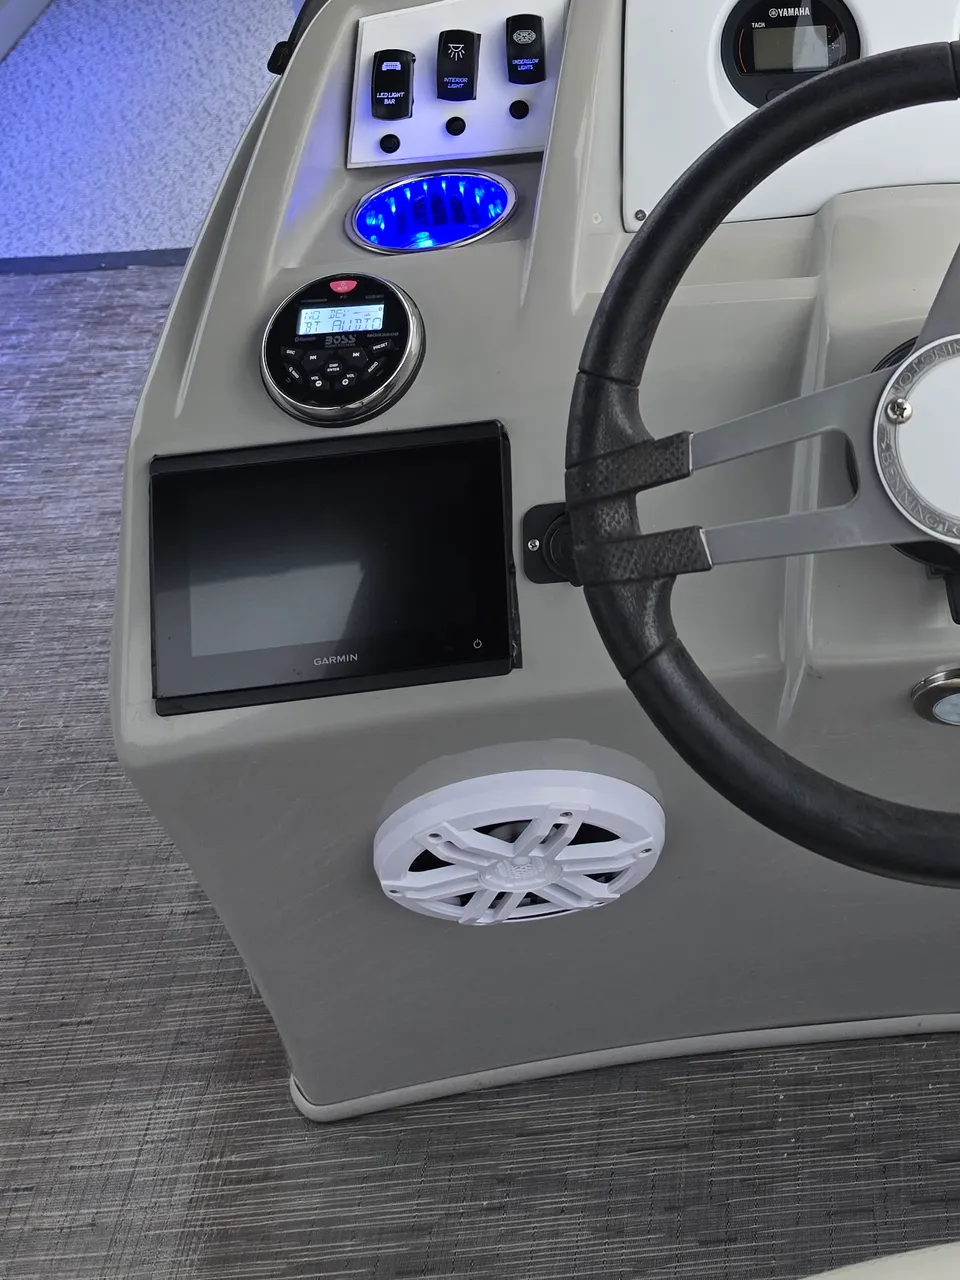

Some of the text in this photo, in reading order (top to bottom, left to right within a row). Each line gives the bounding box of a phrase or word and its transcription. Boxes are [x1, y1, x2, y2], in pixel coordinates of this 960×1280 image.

[778, 7, 811, 17] YAMAHA
[325, 334, 356, 345] BOSS
[313, 652, 359, 666] GARMIN
